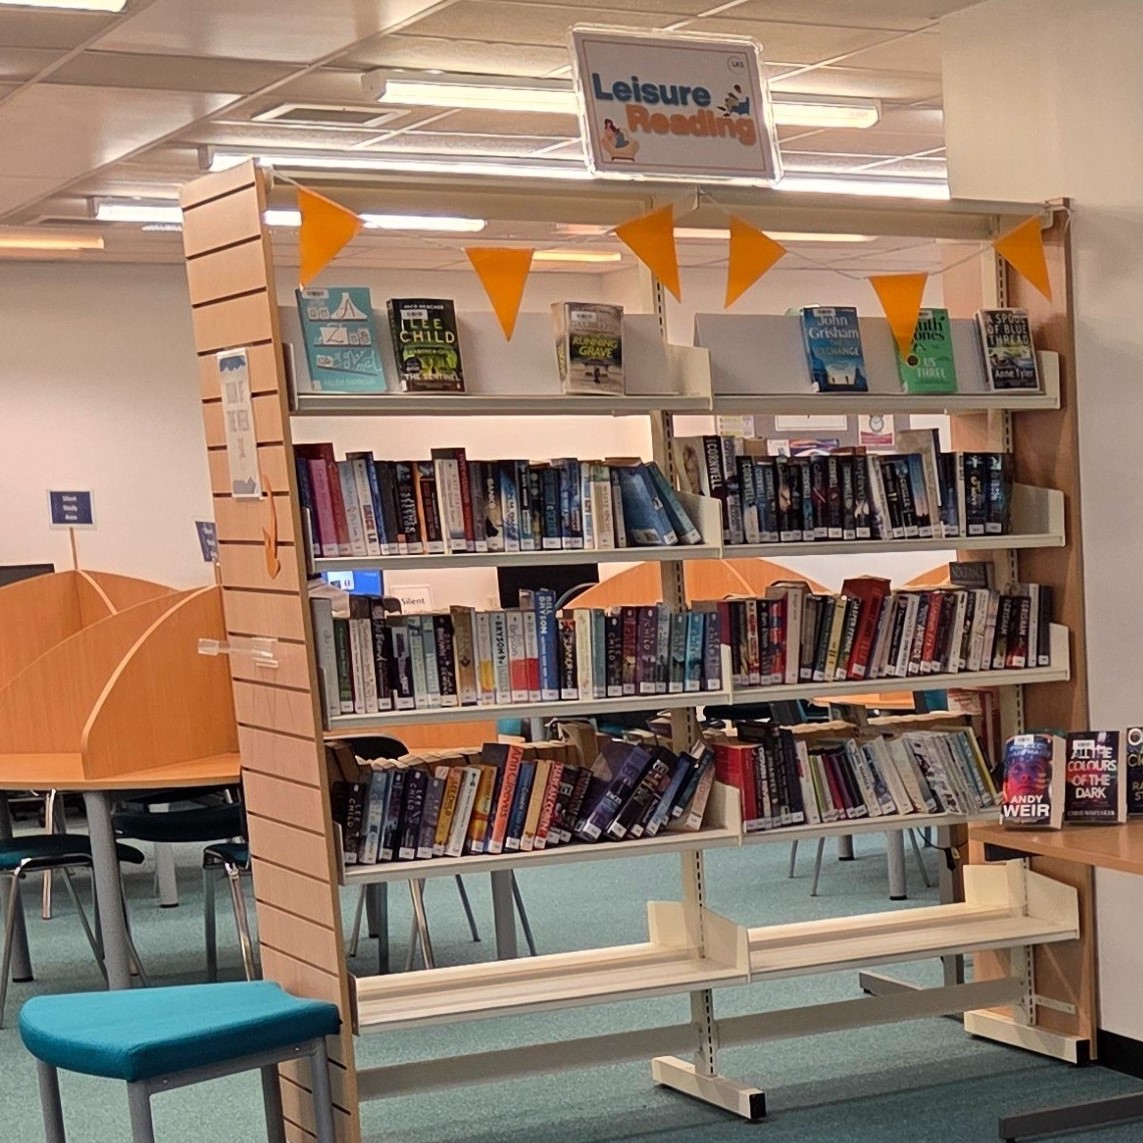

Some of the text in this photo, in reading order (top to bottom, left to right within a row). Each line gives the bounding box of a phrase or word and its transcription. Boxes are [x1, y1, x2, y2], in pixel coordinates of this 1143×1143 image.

[592, 72, 711, 107] Leisure
[625, 104, 756, 146] Reading
[410, 319, 442, 329] LEE
[817, 314, 848, 326] John
[916, 317, 943, 331] uth
[985, 314, 994, 324] A
[809, 327, 859, 339] Grisham
[913, 332, 945, 340] ones
[987, 324, 1027, 335] OF BLUE
[400, 331, 455, 343] CHILD
[573, 336, 618, 349] RUNNING
[988, 335, 1030, 346] THREAD
[579, 347, 614, 358] GRAVE
[923, 357, 937, 367] US
[917, 367, 946, 379] THREE
[995, 369, 1014, 378] Anne
[707, 443, 722, 490] CORNWELL
[742, 464, 755, 501] CORNWELL
[367, 533, 377, 544] LA
[401, 597, 425, 606] Silent
[538, 596, 548, 634] BRYSON
[1000, 603, 1012, 635] GRISHAM
[1017, 603, 1030, 636] GRISHAM
[495, 621, 505, 654] BRYSON
[642, 622, 651, 650] CHILD
[607, 632, 616, 660] CHILD
[1091, 746, 1113, 759] THE
[1067, 760, 1117, 772] COLOURS
[500, 747, 522, 819] Ann Cleeves
[548, 762, 564, 800] HARLAN
[1071, 773, 1111, 786] OF THE
[406, 782, 418, 810] CHILD
[414, 789, 424, 806] LEE
[1010, 794, 1043, 803] ANDY
[1075, 787, 1107, 799] DARK
[345, 798, 358, 828] CHILD
[353, 804, 363, 822] LEE
[1003, 803, 1050, 817] WEIR
